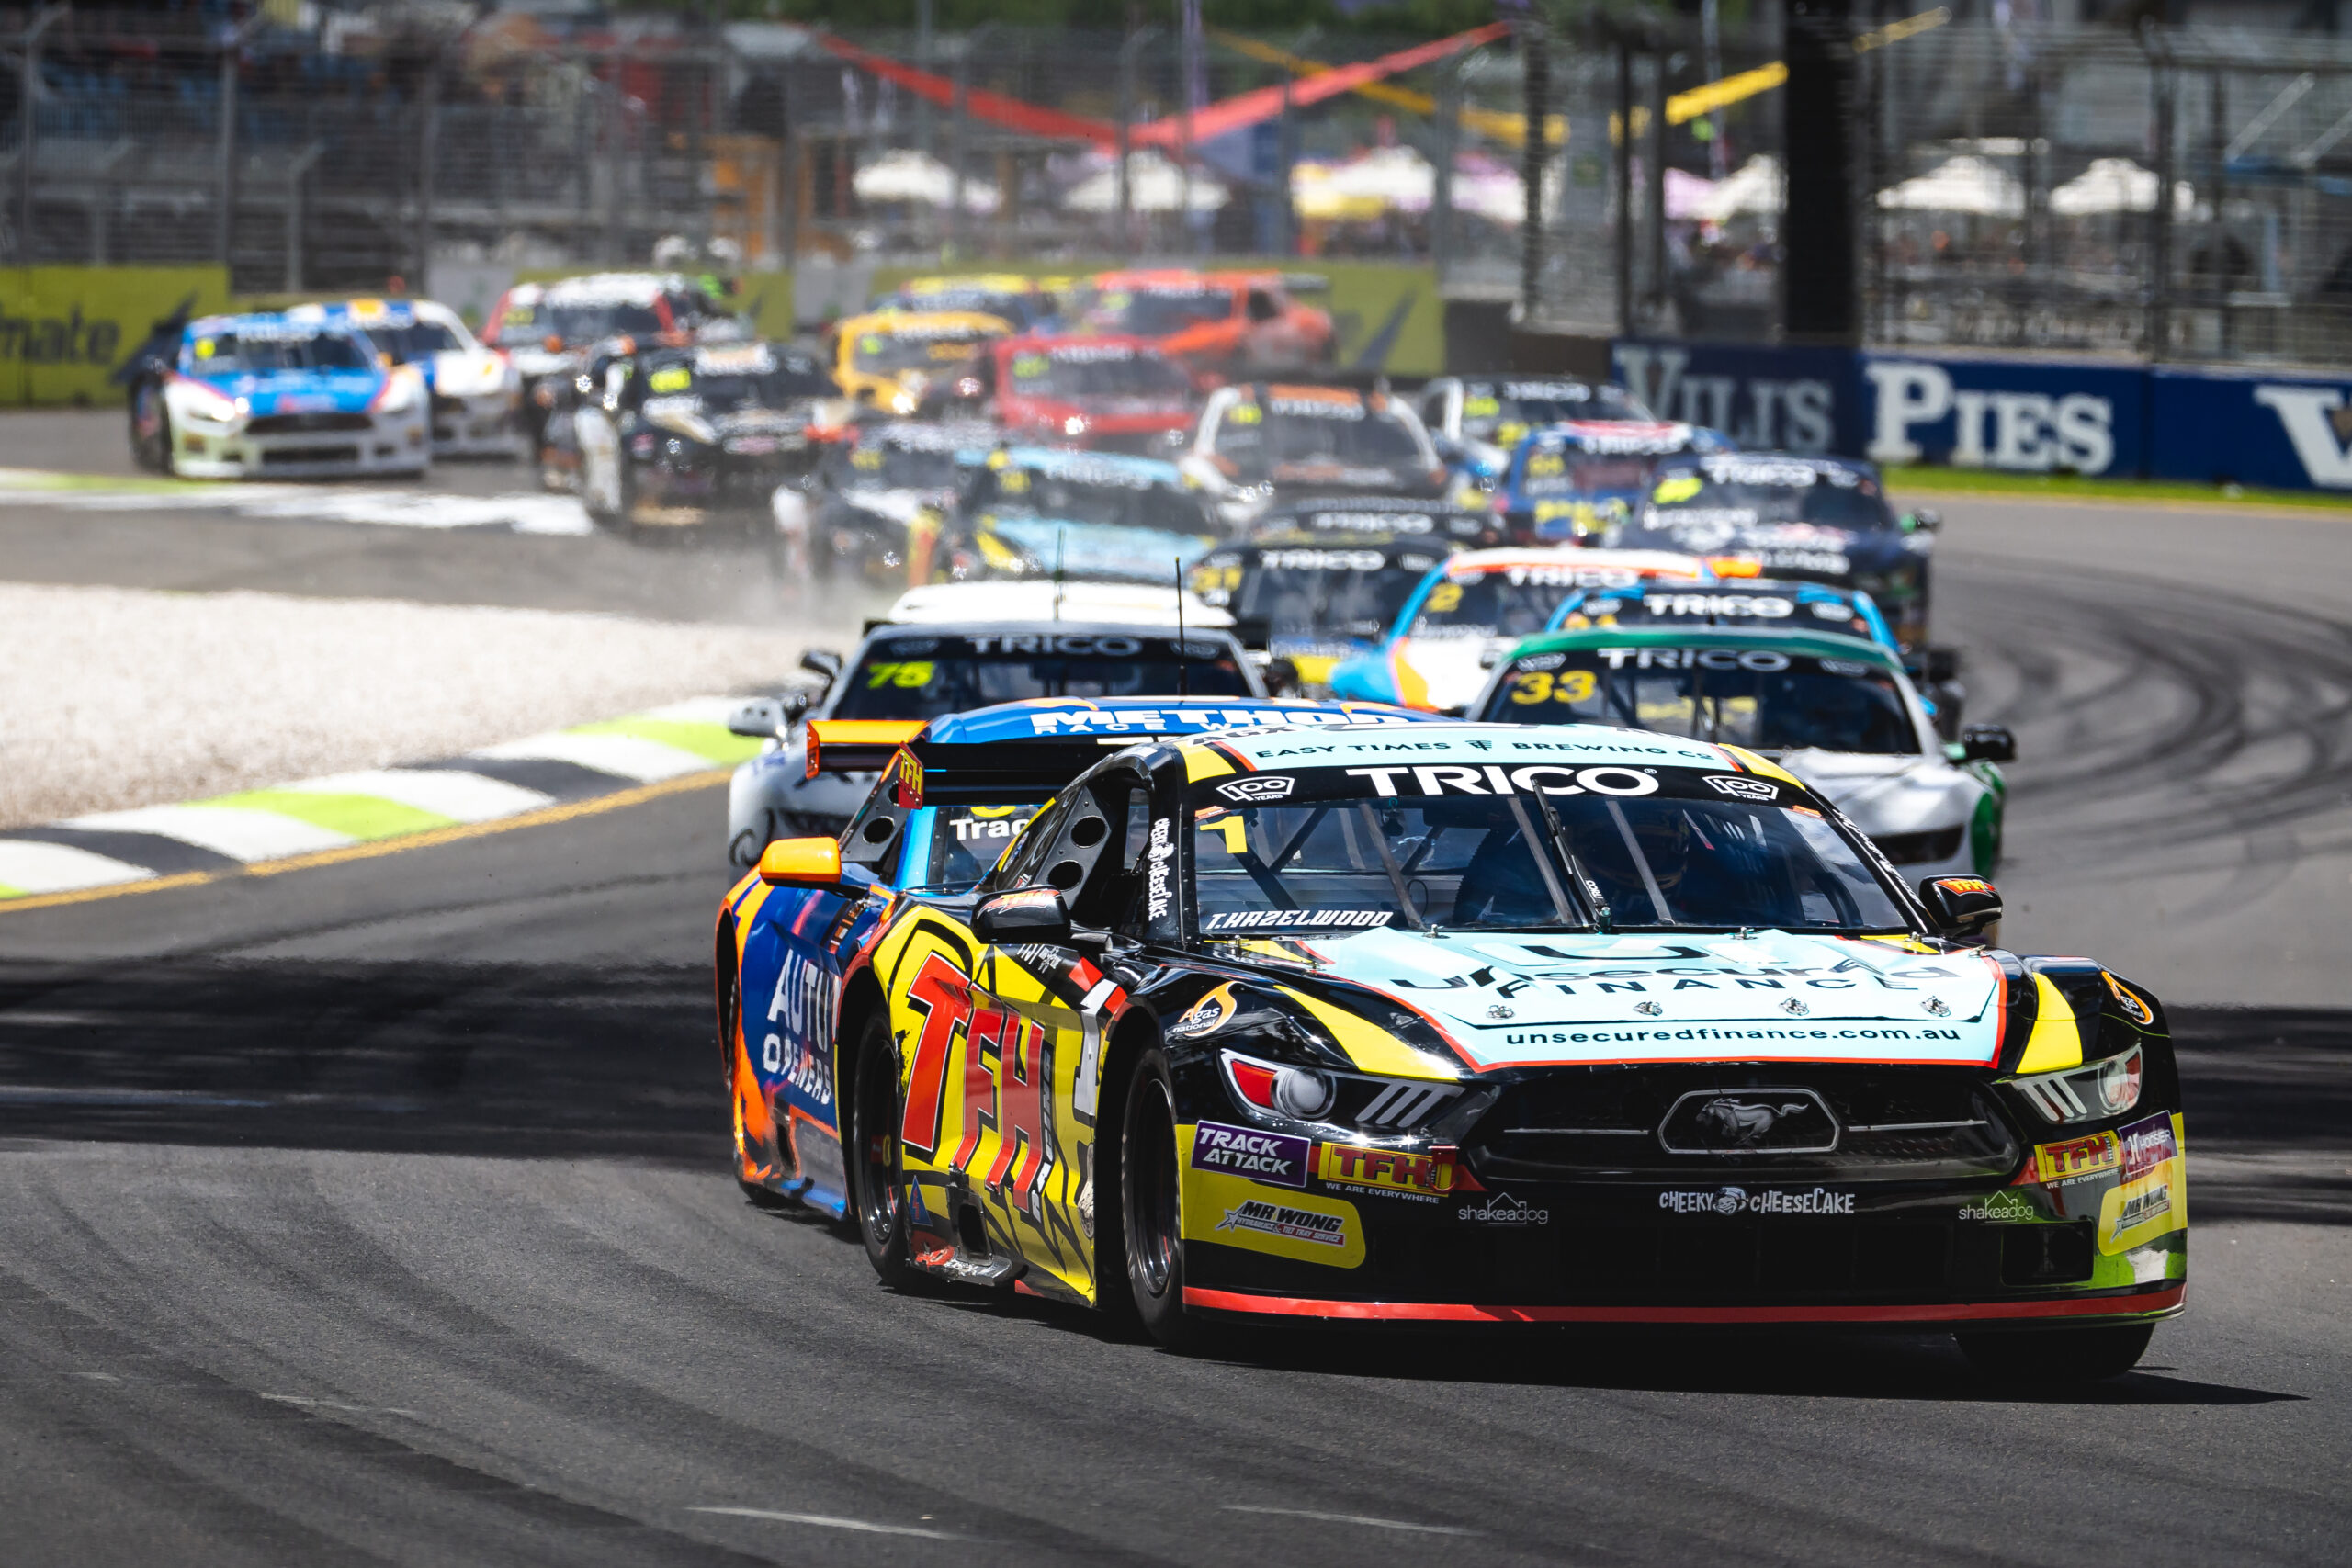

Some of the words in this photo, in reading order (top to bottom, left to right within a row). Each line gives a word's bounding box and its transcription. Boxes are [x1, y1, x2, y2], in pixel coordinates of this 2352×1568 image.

[1868, 362, 2114, 475] PIES
[1507, 566, 1639, 587] TRICO
[1643, 594, 1794, 618] TRICO
[965, 636, 1143, 657] TRICO
[1598, 648, 1792, 671] TRICO
[1511, 670, 1598, 705] 33
[1035, 723, 1168, 735] RACE
[1256, 745, 1336, 759] EASY
[1347, 742, 1451, 753] TIMES
[1512, 742, 1668, 754] BREWING
[899, 748, 923, 795] TFH
[1345, 766, 1659, 797] TRICO
[1227, 779, 1283, 801] 100
[1713, 778, 1771, 797] 100
[1199, 815, 1248, 853] 1
[1948, 880, 1985, 892] TFH
[1205, 909, 1394, 930] T.HAZELWOOD
[767, 948, 830, 1053] AUTO
[1496, 978, 1919, 999] FINANCE
[1172, 1019, 1216, 1032] national
[1177, 1007, 1220, 1025] Agas
[1507, 1027, 1961, 1045] unsecuredfinance.com.au
[900, 951, 1045, 1213] TFH
[1199, 1127, 1283, 1156] TRACK
[1203, 1148, 1292, 1175] ATTACK
[2045, 1136, 2109, 1173] TFH
[1334, 1148, 1427, 1186] TFH
[1326, 1182, 1341, 1190] WE
[1345, 1185, 1364, 1194] ARE
[1368, 1189, 1440, 1204] EVERYWHERE
[2046, 1180, 2059, 1190] WE
[2061, 1178, 2076, 1187] ARE
[1458, 1198, 1549, 1224] shakeadog
[1659, 1190, 1715, 1213] CHEEKY
[1750, 1186, 1855, 1214] CHEESECAKE
[1958, 1196, 2034, 1220] shakeadog
[1242, 1201, 1277, 1220] MR
[1276, 1207, 1344, 1233] WONG
